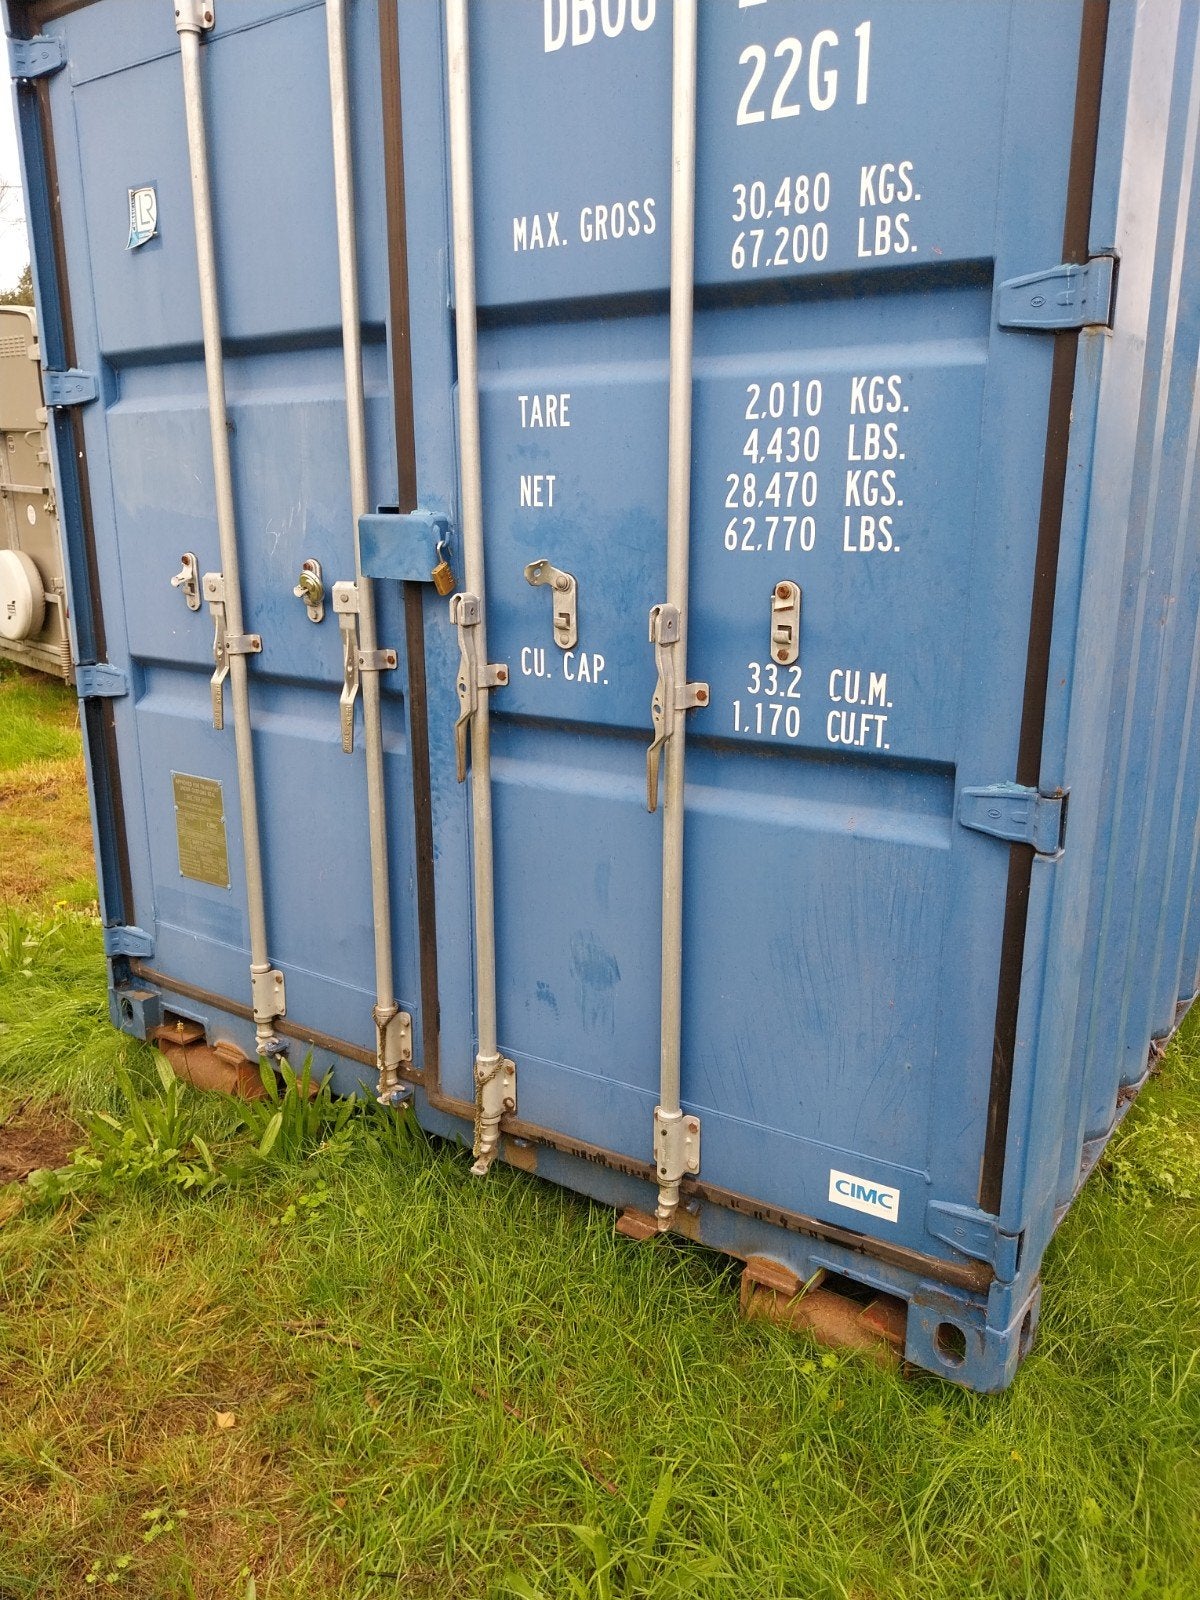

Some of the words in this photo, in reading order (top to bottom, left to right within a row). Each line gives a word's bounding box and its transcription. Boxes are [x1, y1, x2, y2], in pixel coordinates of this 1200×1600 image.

[736, 20, 871, 125] 22G1
[513, 212, 567, 251] MAX.
[580, 198, 656, 242] GROSS
[732, 172, 830, 222] 30,480
[860, 161, 921, 207] KGS.
[732, 222, 828, 269] 67,200
[858, 213, 917, 257] LBS.
[518, 394, 570, 427] TARE
[745, 380, 822, 419] 2,010
[851, 375, 908, 414] KGS.
[743, 426, 819, 464] 4,430
[848, 423, 905, 460] LBS.
[521, 475, 555, 507] NET
[725, 471, 817, 507] 28,470
[846, 470, 903, 506] KGS.
[725, 516, 815, 551] 62,770
[844, 516, 900, 552] LBS.
[522, 647, 551, 678] CU.
[564, 651, 608, 684] CAP.
[748, 662, 801, 698] 33.2
[733, 701, 800, 737] 1,170
[835, 1179, 894, 1210] CIMC
